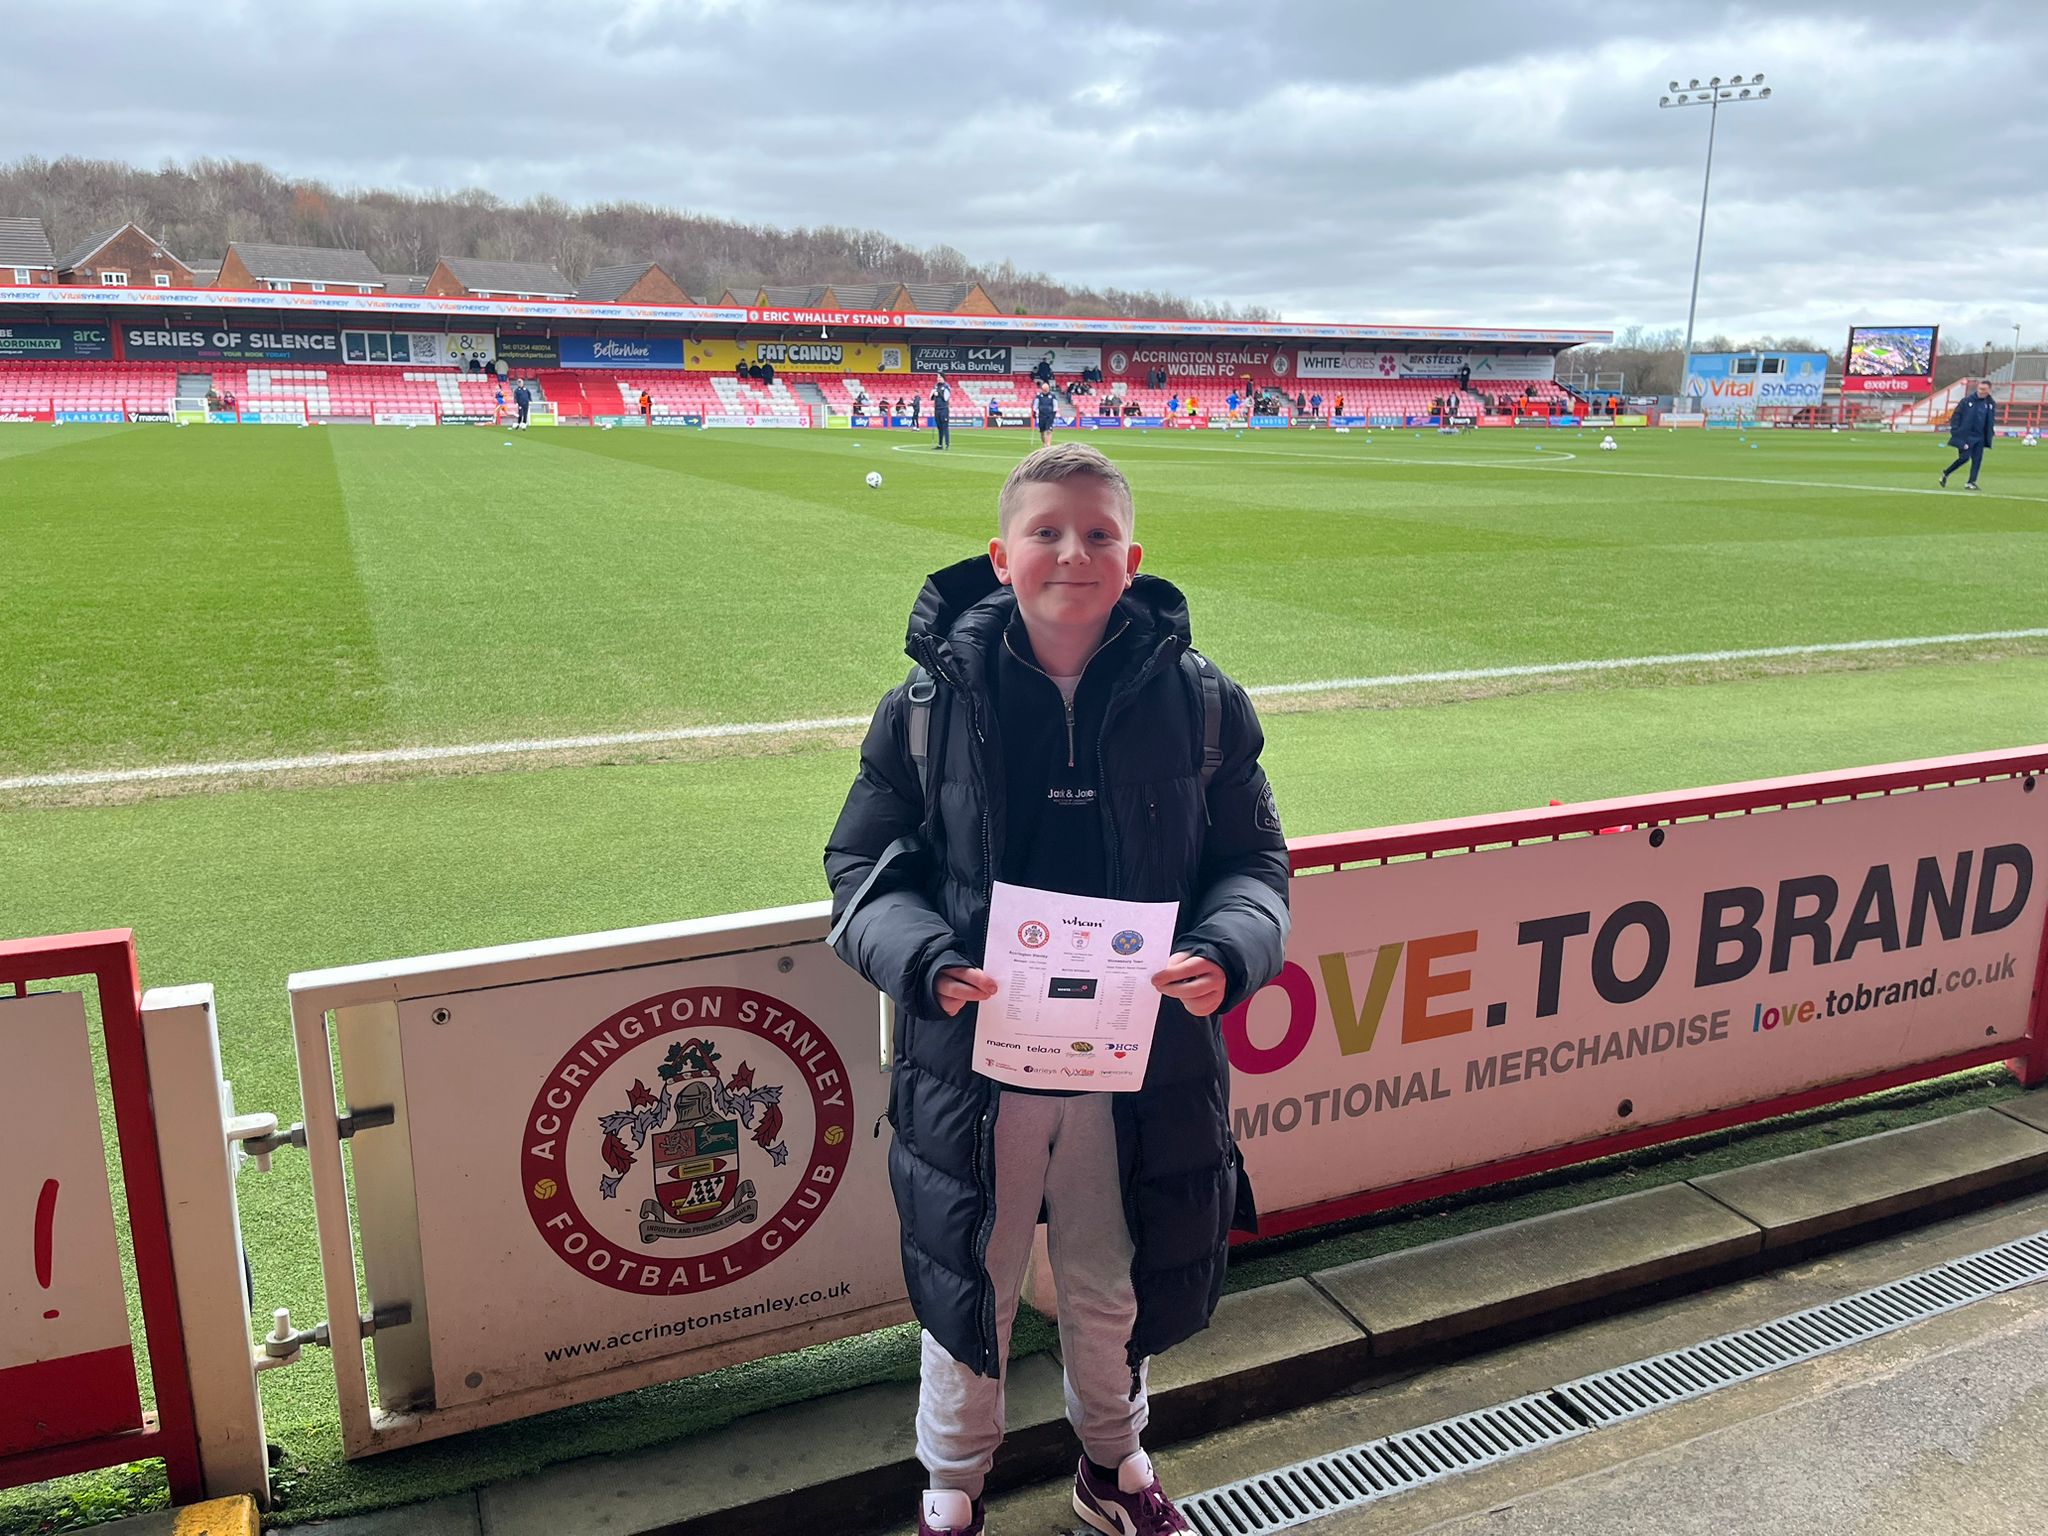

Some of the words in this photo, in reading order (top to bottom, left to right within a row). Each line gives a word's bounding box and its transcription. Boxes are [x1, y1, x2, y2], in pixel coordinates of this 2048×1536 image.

[763, 312, 790, 322] ERIC
[793, 312, 849, 324] WHALLEY
[852, 314, 890, 325] STAND
[129, 330, 205, 347] SERIES
[212, 332, 242, 348] OF
[249, 333, 336, 350] SILENCE
[757, 344, 786, 361] FAT
[788, 345, 842, 362] CANDY
[918, 348, 957, 358] PERRYS
[1132, 351, 1213, 364] ACCRINGTON
[1216, 352, 1269, 364] STANLEY
[1304, 357, 1376, 369] WHITEACRES
[1426, 356, 1464, 364] STEELS
[916, 360, 949, 372] Perrys
[950, 361, 966, 370] Kia
[968, 362, 1004, 374] Burnley
[1168, 364, 1216, 376] WOMEN
[1218, 364, 1235, 376] FC
[1710, 379, 1754, 398] Vital
[1761, 383, 1821, 397] SYNERGY
[1863, 378, 1909, 390] exertis
[856, 418, 868, 426] sky
[1048, 789, 1065, 798] Jack
[1066, 789, 1073, 798] &
[1220, 900, 1671, 1076] OVE.TO
[1694, 842, 2034, 988] BRAND
[1752, 952, 2017, 1033] love.tobrand.co.uk
[986, 1040, 1021, 1050] macron
[531, 995, 723, 1161] ACCRINGTON
[738, 1000, 845, 1108] STANLEY
[1232, 1067, 1451, 1142] MOTIONAL
[1464, 1009, 1731, 1093] MERCHANDISE
[546, 1210, 742, 1288] FOOTBALL
[760, 1162, 836, 1252] CLUB
[646, 1224, 678, 1234] INDUSTRY
[544, 1280, 852, 1363] www.accringtonstanley.co.uk
